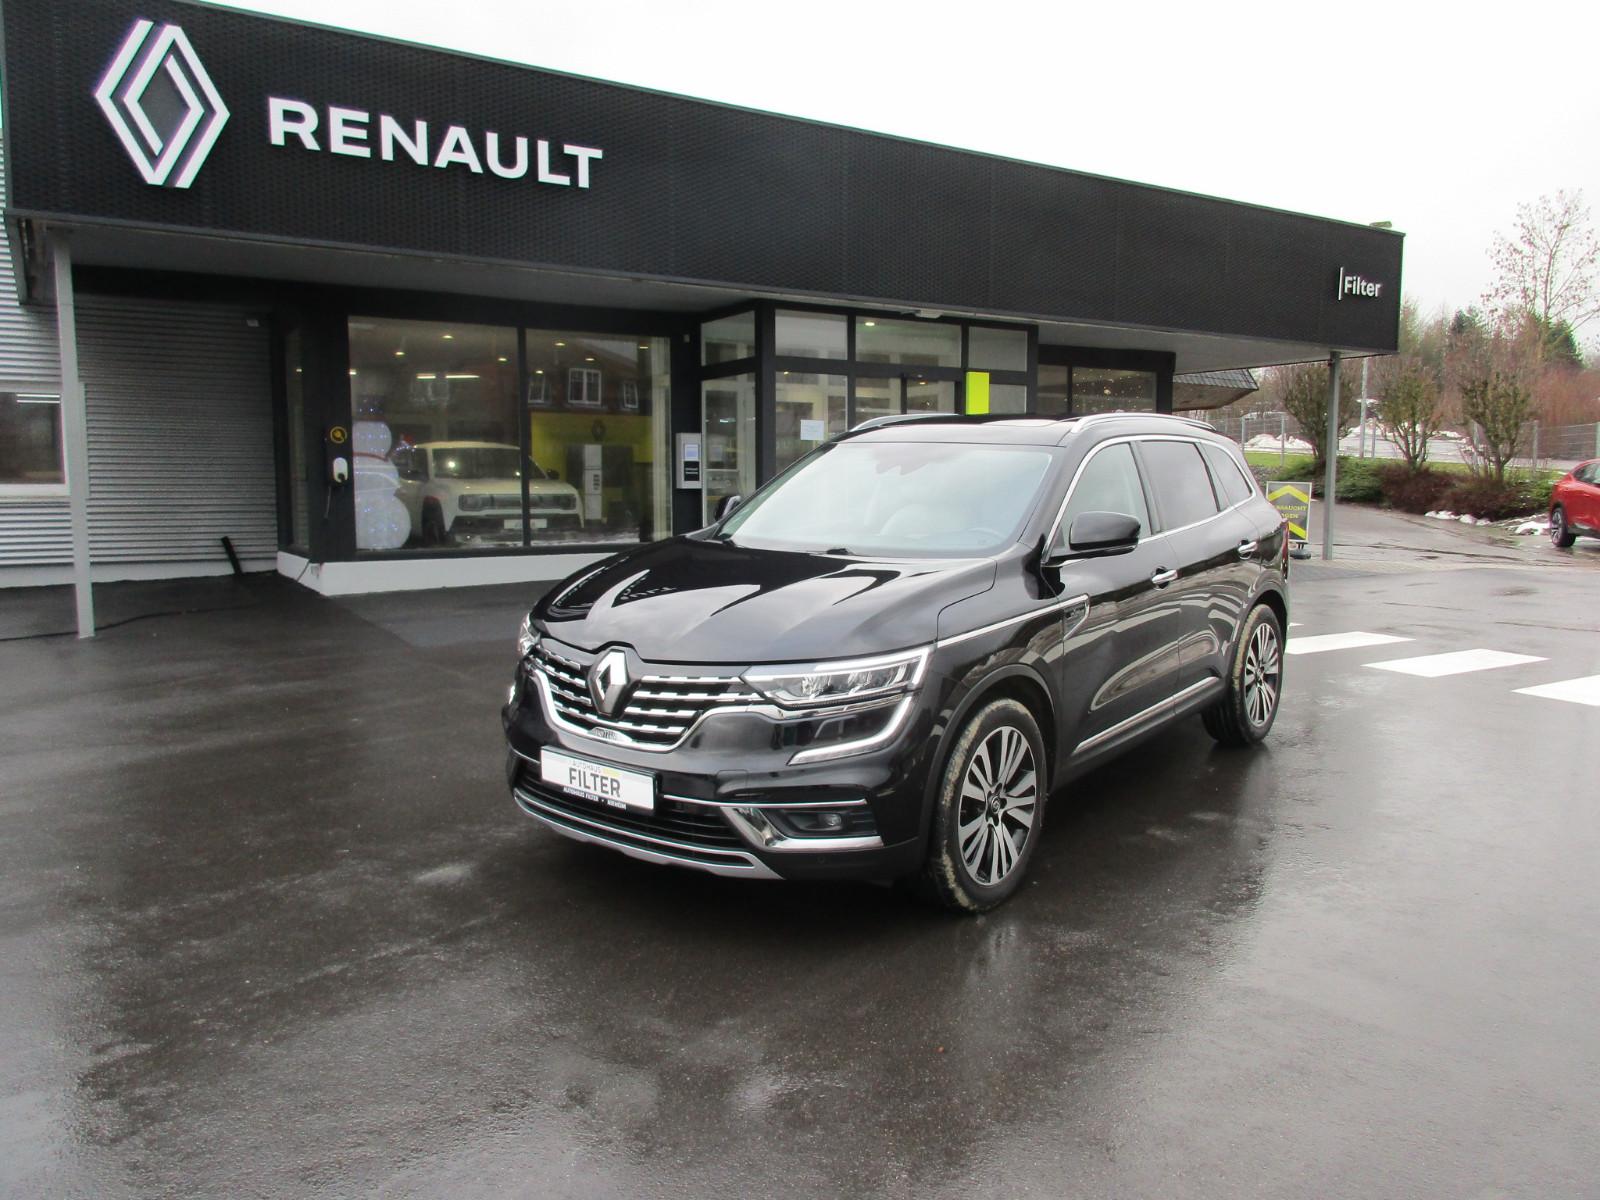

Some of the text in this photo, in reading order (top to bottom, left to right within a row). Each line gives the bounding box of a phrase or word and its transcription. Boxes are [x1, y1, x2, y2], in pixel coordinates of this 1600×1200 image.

[269, 97, 603, 189] RENAULT
[1344, 275, 1382, 297] Filter
[569, 767, 621, 798] FILTER
